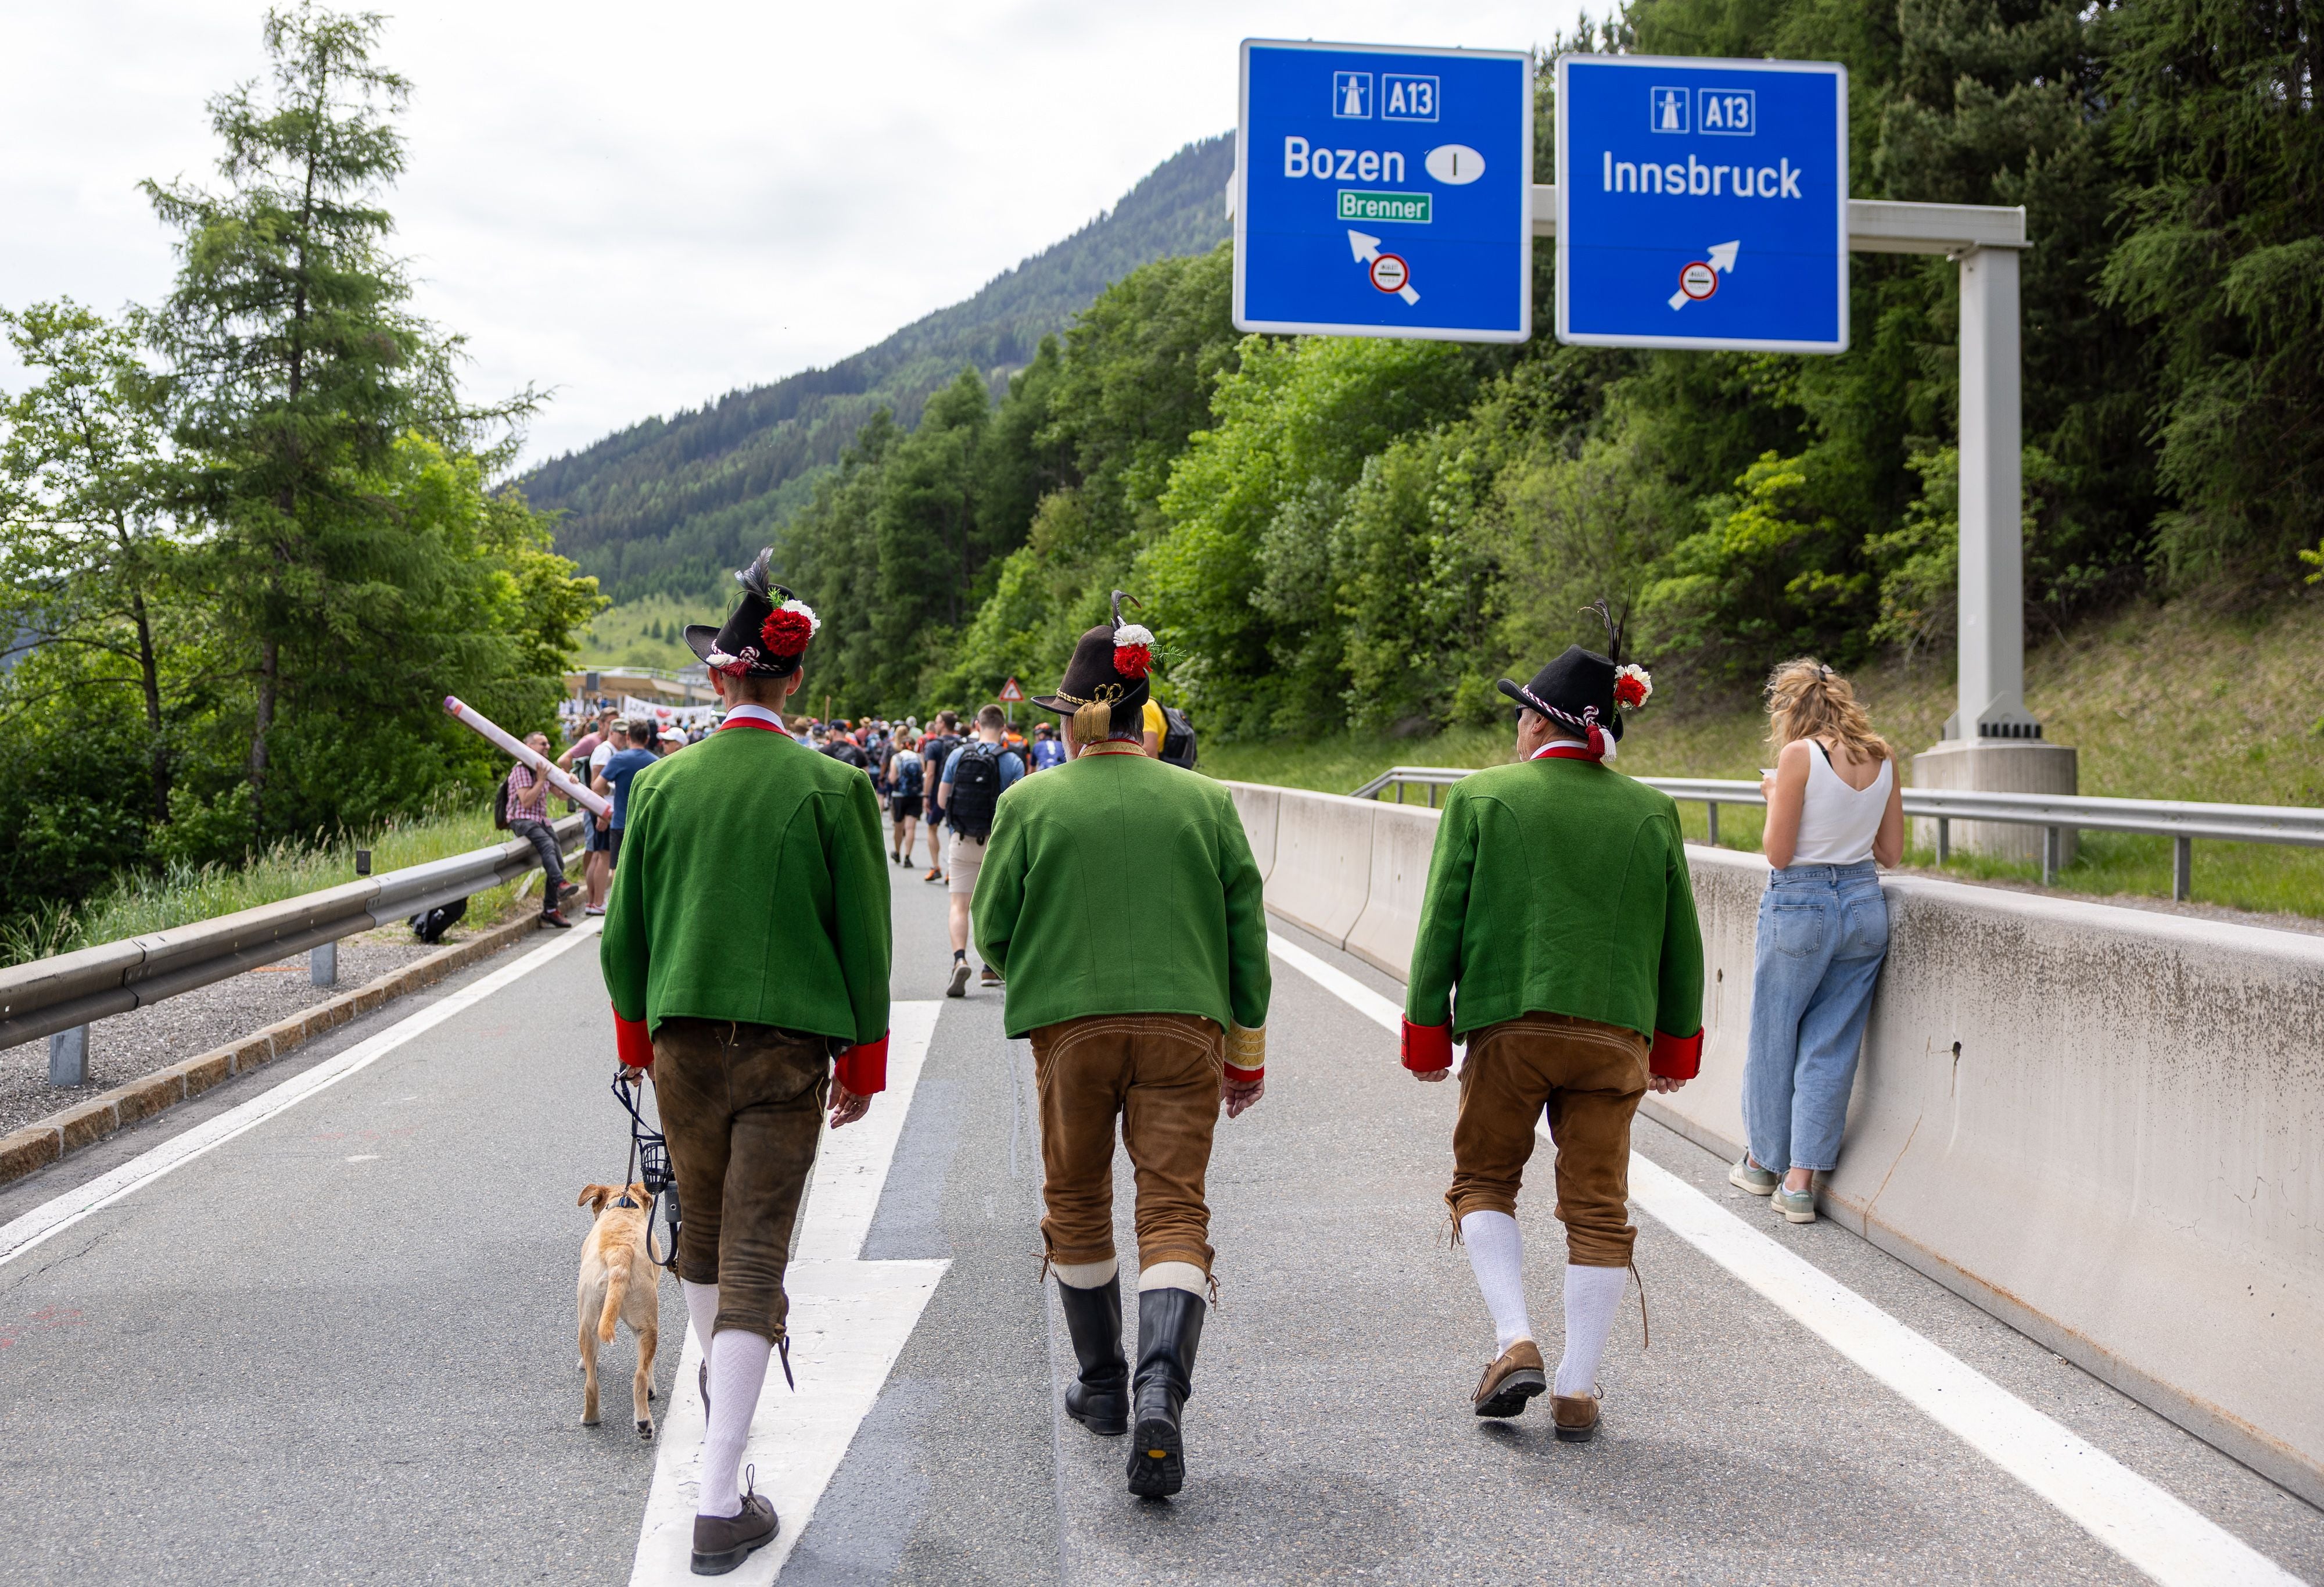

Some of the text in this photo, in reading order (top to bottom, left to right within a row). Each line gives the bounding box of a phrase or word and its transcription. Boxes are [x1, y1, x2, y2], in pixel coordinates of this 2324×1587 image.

[1389, 81, 1433, 114] A13
[1706, 96, 1748, 128] A13
[1285, 136, 1404, 182] Bozen
[1604, 151, 1801, 198] Innsbruck
[1343, 194, 1426, 218] Brenner
